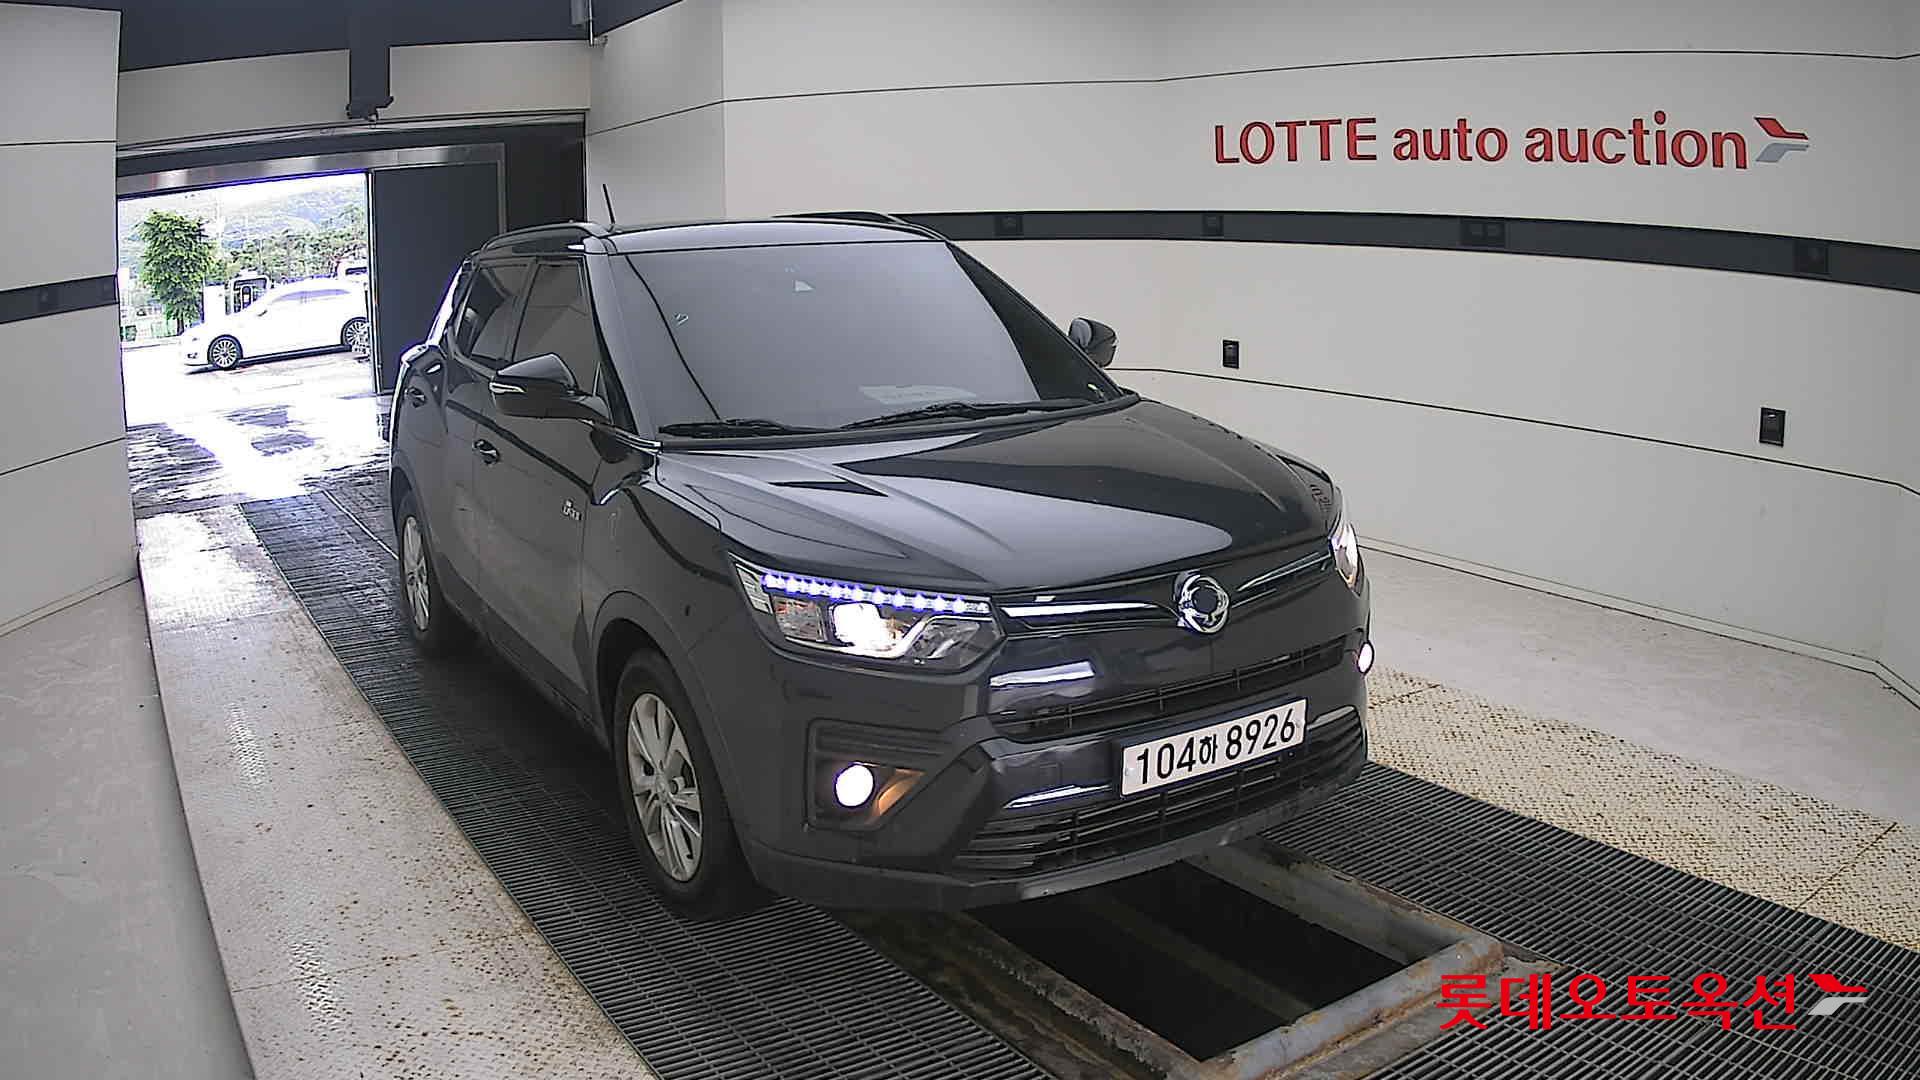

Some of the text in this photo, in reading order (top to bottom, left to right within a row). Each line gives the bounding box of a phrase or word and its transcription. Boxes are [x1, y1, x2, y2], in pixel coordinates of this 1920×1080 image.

[1214, 110, 1749, 170] LOTTE auto auction
[1224, 707, 1297, 761] 8926
